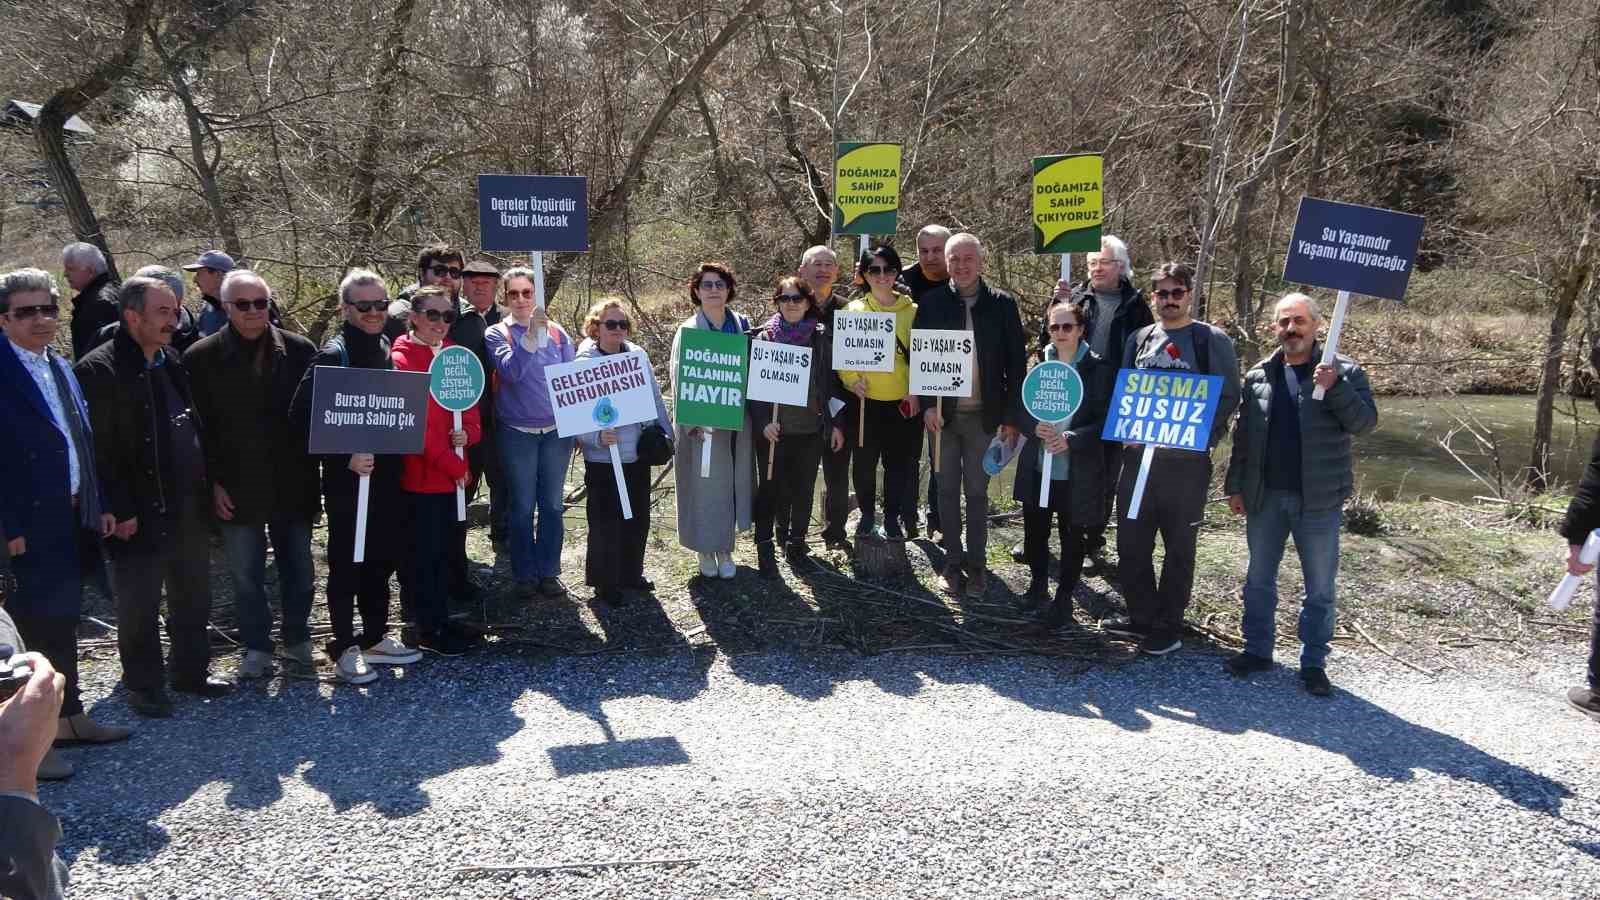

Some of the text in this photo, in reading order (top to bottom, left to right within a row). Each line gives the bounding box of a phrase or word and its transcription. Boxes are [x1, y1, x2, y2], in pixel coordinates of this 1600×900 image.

[839, 167, 897, 178] DOĞAMIZA
[851, 180, 884, 191] SAHİP
[1036, 182, 1099, 194] DOĞAMIZA
[491, 196, 577, 212] Dereler Özgürdür
[838, 195, 896, 206] ÇIKIYORUZ
[1049, 195, 1086, 208] SAHİP
[500, 211, 568, 227] Özgür Akacak
[1036, 211, 1099, 224] ÇIKIYORUZ
[1321, 227, 1392, 251] Su Yaşamdır
[1298, 240, 1408, 272] Yaşamı Koruyacağız
[837, 318, 847, 330] SU
[854, 318, 878, 334] YAŞAM
[844, 337, 884, 349] OLMASIN
[912, 338, 922, 352] SU
[929, 339, 955, 356] YAŞAM
[685, 349, 741, 367] DOĞANIN
[753, 346, 764, 361] SU
[770, 350, 795, 366] YAŞAM
[444, 365, 468, 377] DEĞİL
[551, 355, 642, 392] GELECEĞİMİZ
[682, 365, 742, 383] TALANINA
[920, 361, 962, 374] OLMASIN
[441, 376, 472, 388] SİSTEMİ
[760, 368, 800, 384] OLMASIN
[556, 372, 646, 408] KURUMASIN
[1040, 379, 1065, 390] DEĞİL
[1125, 373, 1208, 400] SUSMA
[335, 392, 405, 409] Bursa Uyuma
[680, 382, 742, 407] HAYIR
[1034, 389, 1069, 401] SİSTEMİ
[1119, 395, 1206, 423] SUSUZ
[324, 410, 416, 430] Suyuna Sahip Çık
[1114, 418, 1196, 447] KALMA
